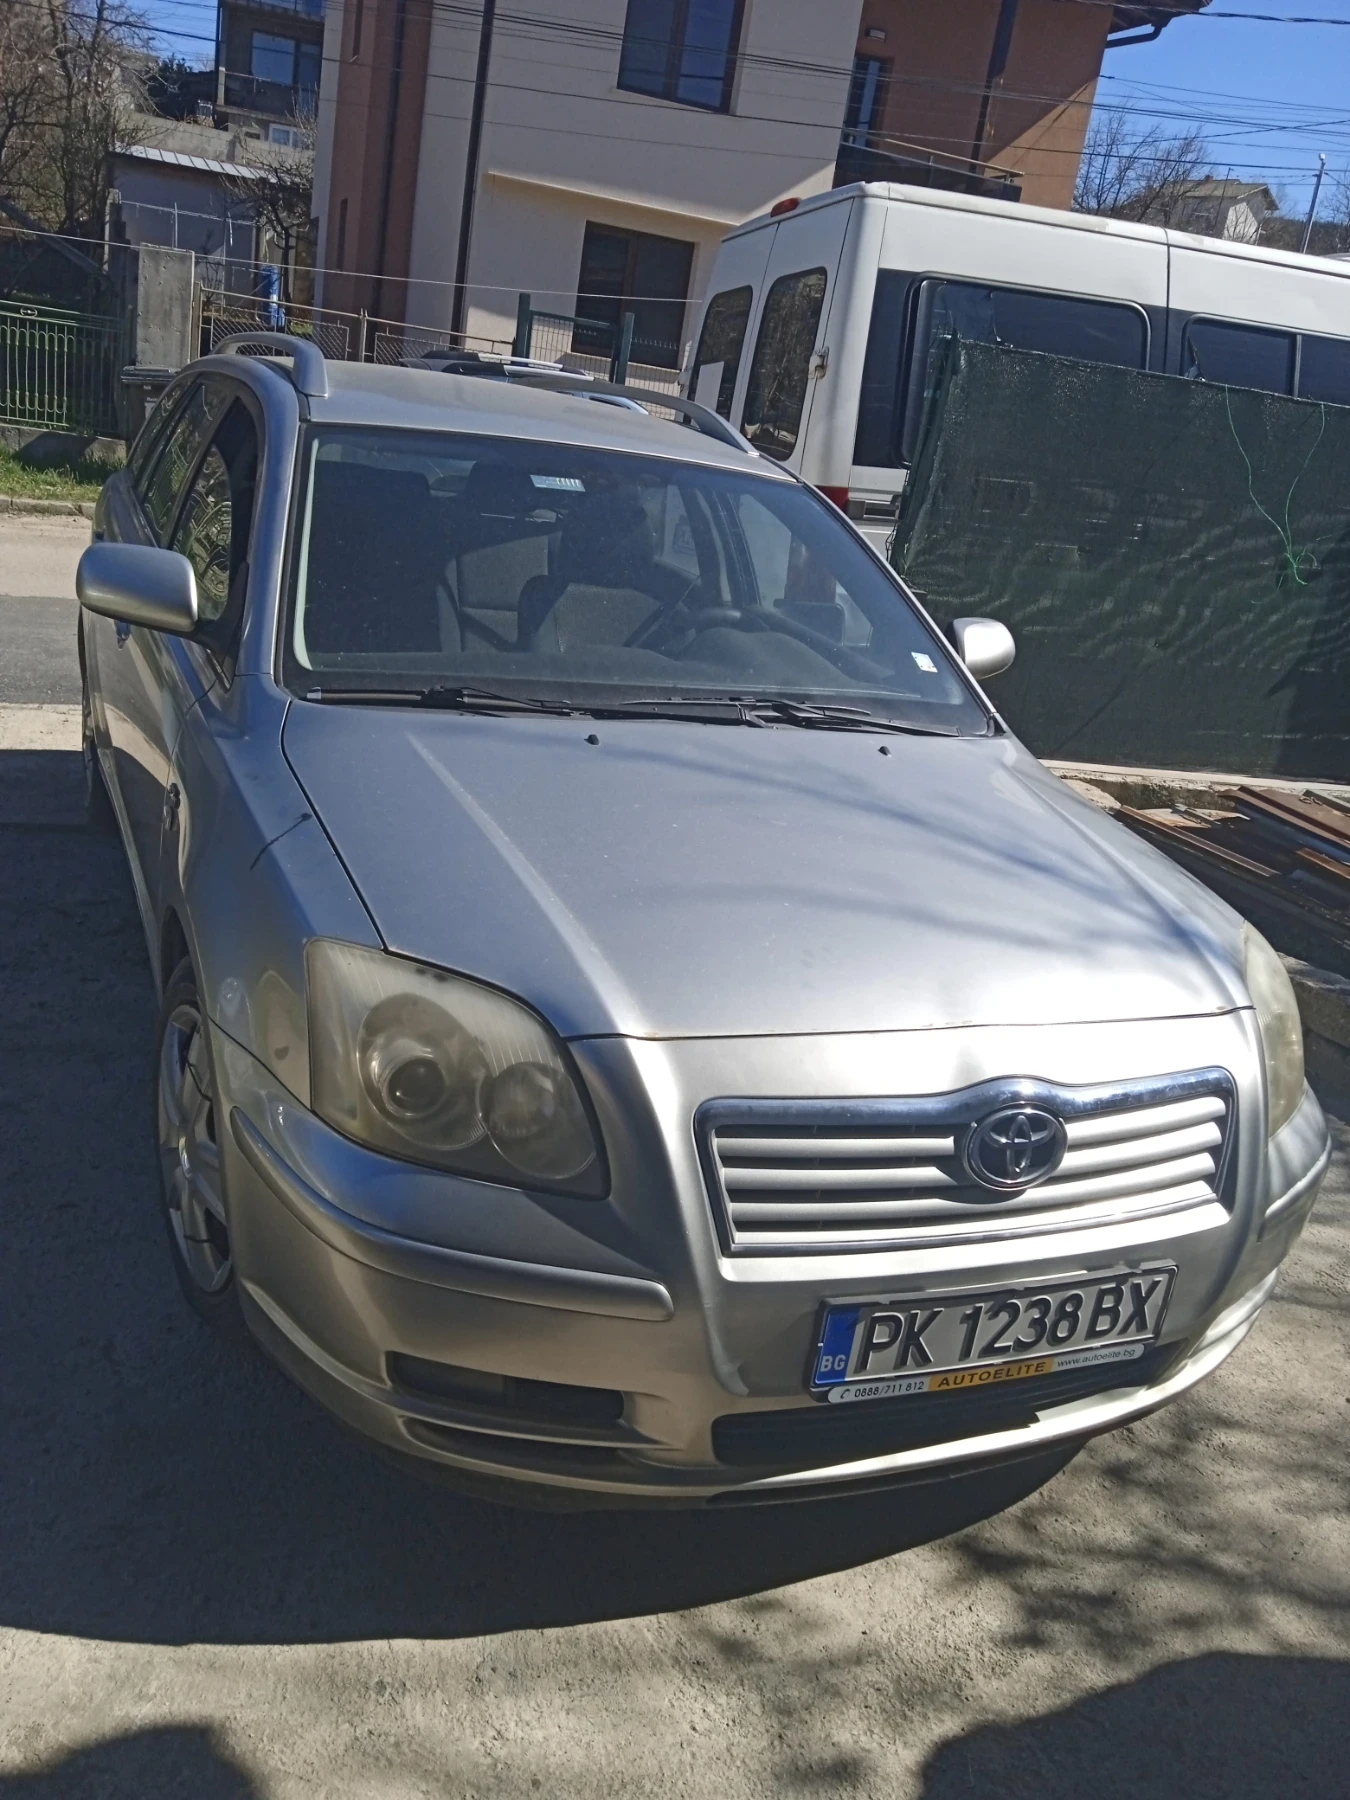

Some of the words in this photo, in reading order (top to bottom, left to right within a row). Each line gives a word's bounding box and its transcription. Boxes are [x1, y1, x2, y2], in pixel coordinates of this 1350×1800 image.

[855, 1308, 943, 1372] PK
[958, 1293, 1085, 1361] 1238
[1085, 1277, 1163, 1339] BX
[820, 1354, 847, 1372] BG
[1057, 1348, 1136, 1367] www.autoelite.bg
[938, 1361, 1046, 1388] AUTOELITE
[854, 1383, 902, 1398] 0888/711
[905, 1381, 924, 1391] 812
